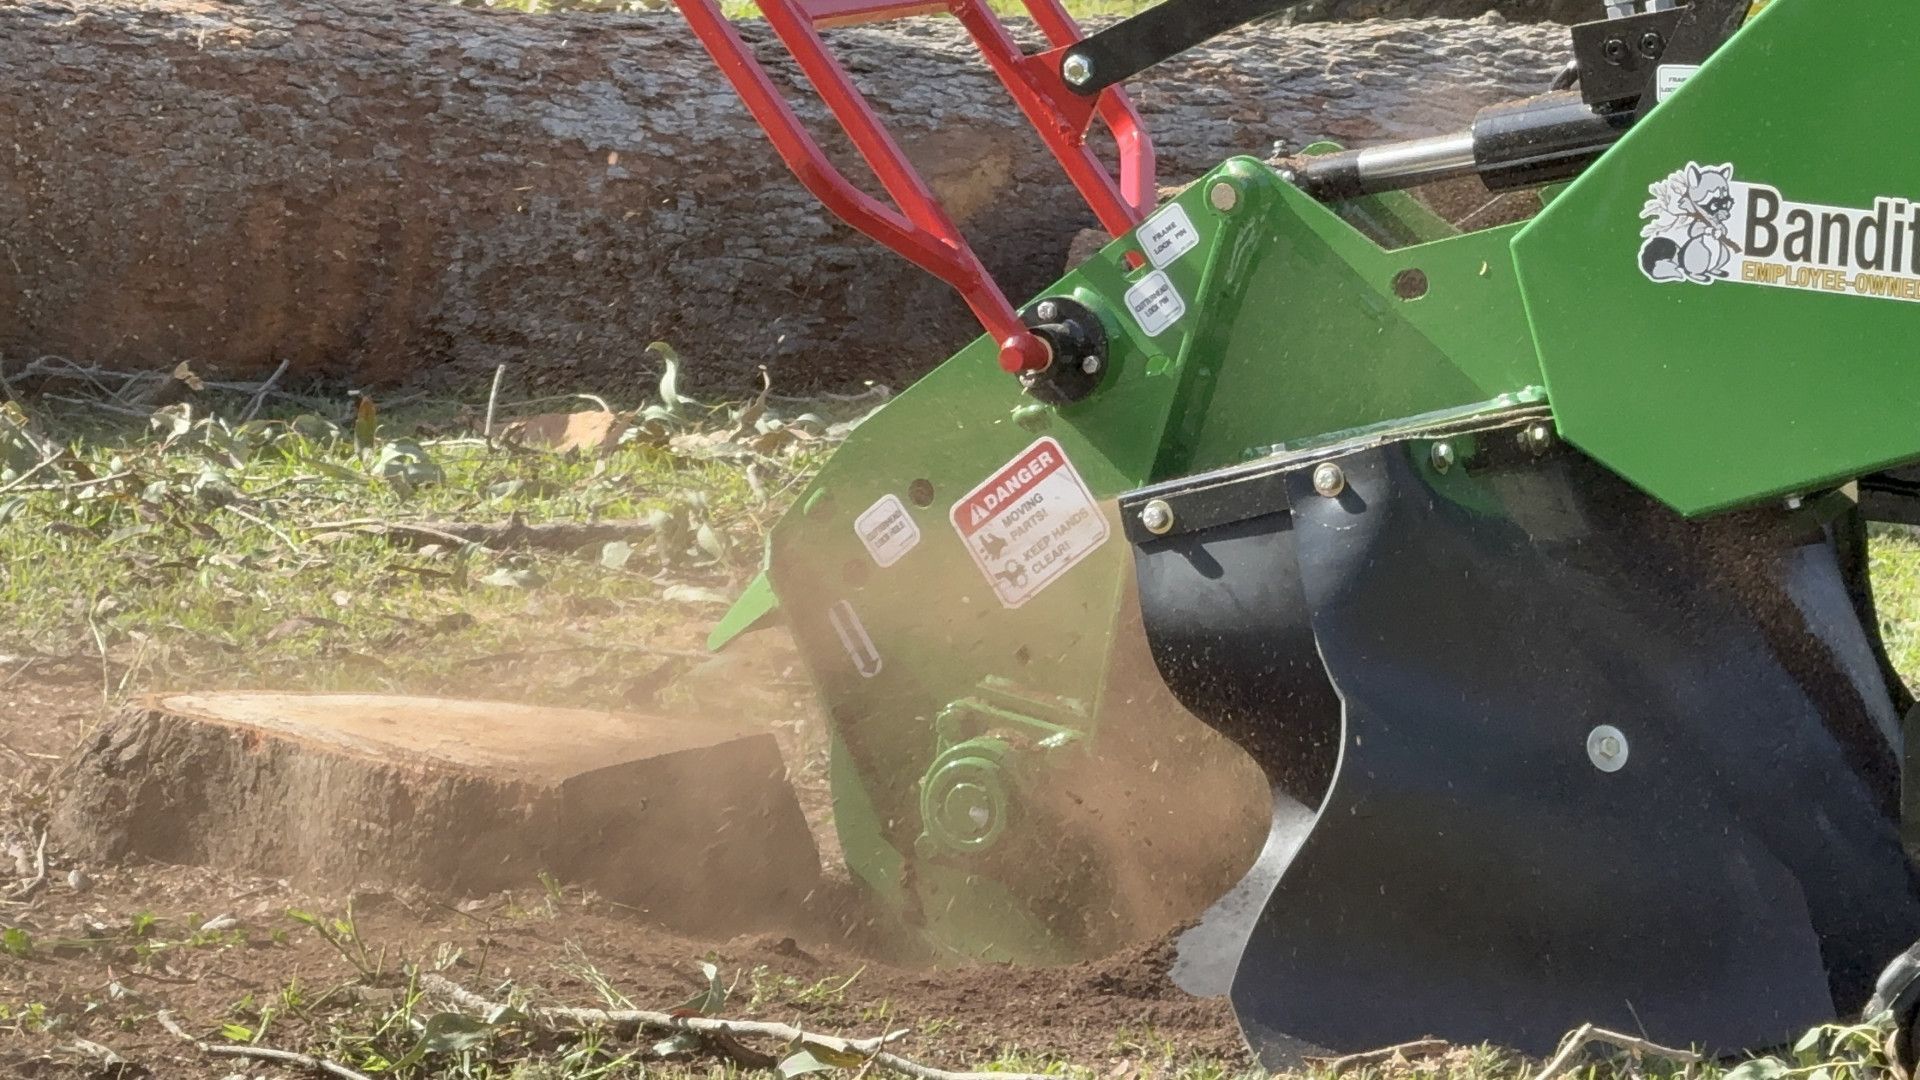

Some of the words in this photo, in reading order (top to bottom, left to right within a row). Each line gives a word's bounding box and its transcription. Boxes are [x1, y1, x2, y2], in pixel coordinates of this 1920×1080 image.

[1152, 221, 1177, 242] FRAME
[1153, 239, 1172, 255] LOCK
[1174, 228, 1187, 240] PIN
[1744, 187, 1920, 275] Bandit
[984, 451, 1054, 510] DANGER
[1002, 492, 1044, 529] MOVING
[1010, 508, 1049, 541] PARTS!
[1022, 535, 1051, 562] KEEP
[1051, 507, 1089, 540] HANDS
[1032, 540, 1072, 574] CLEAR!
